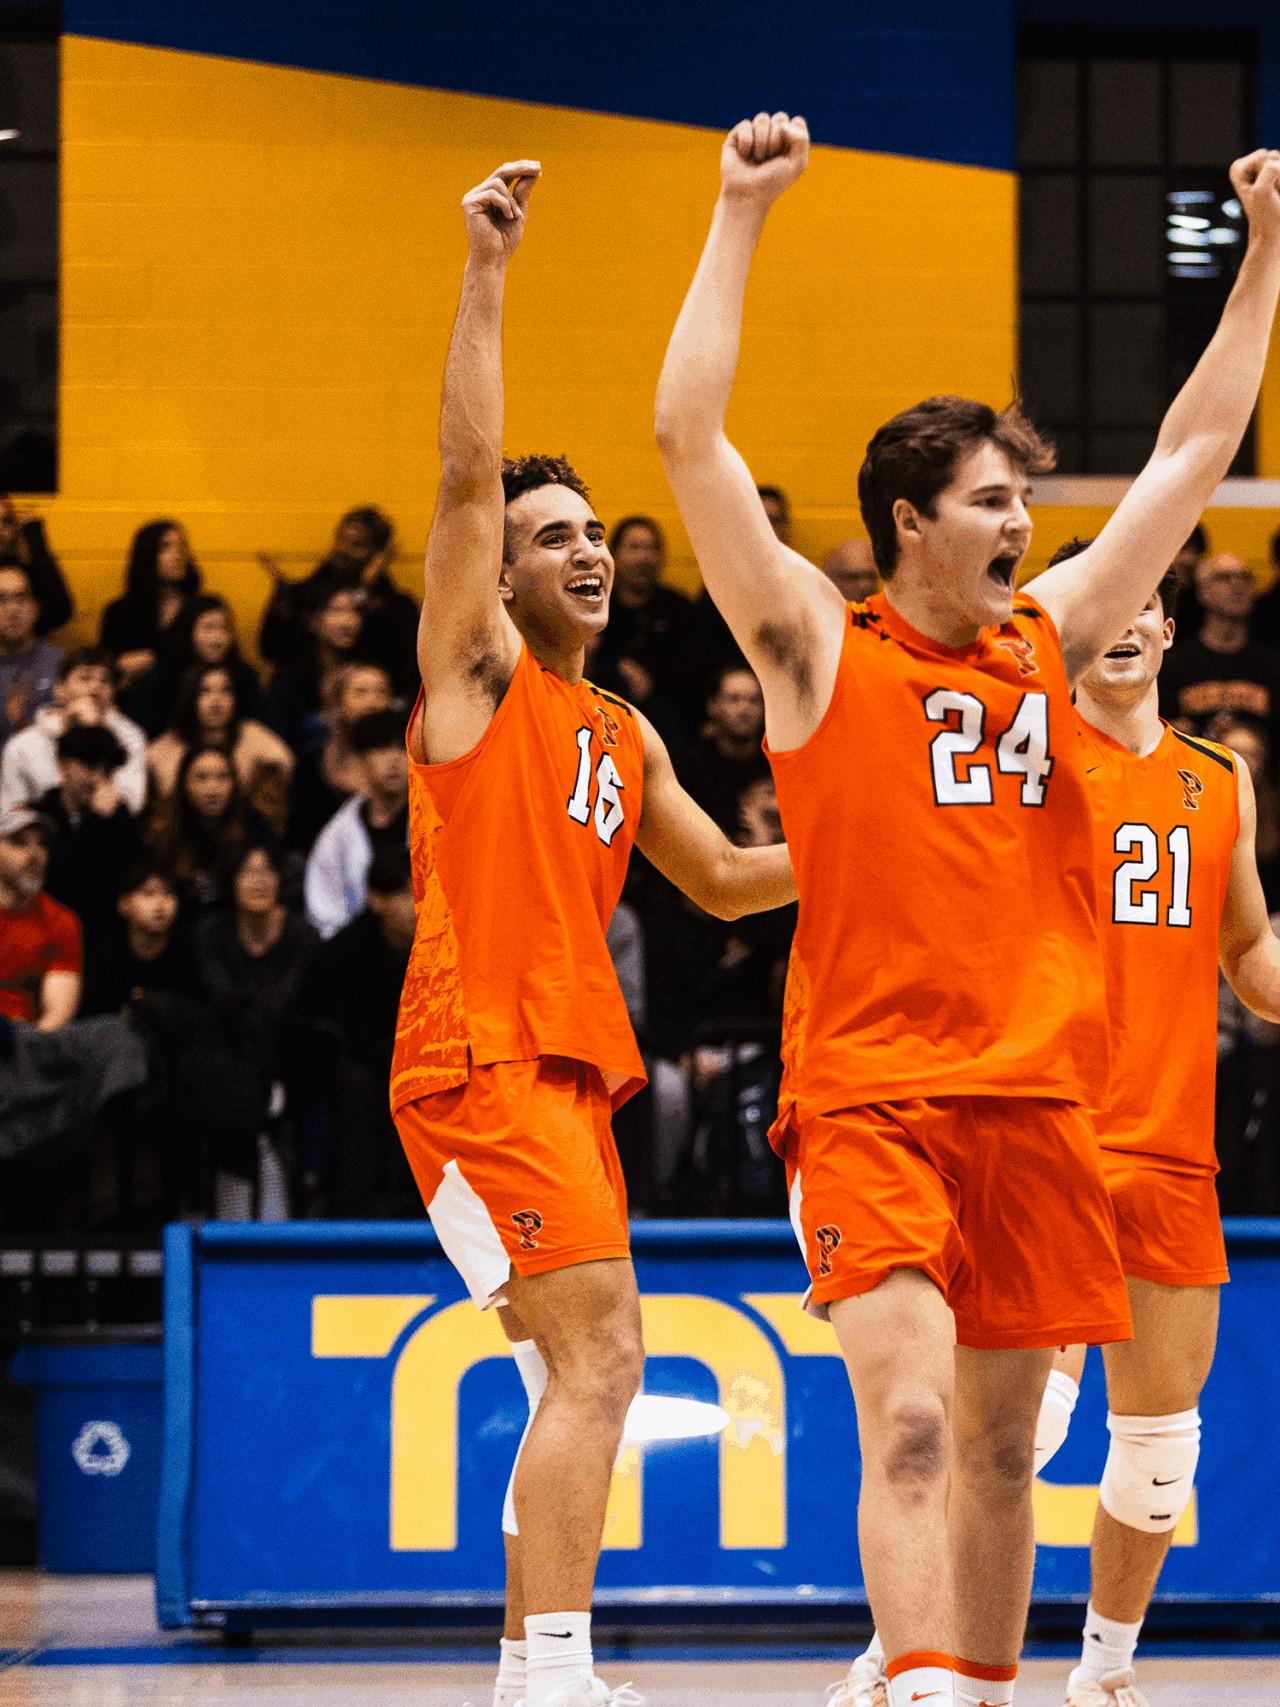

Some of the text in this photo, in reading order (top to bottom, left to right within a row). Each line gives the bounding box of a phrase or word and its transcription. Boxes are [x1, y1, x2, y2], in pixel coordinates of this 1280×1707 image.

[566, 724, 626, 849] 16
[922, 686, 1055, 808] 24
[1111, 821, 1192, 928] 21
